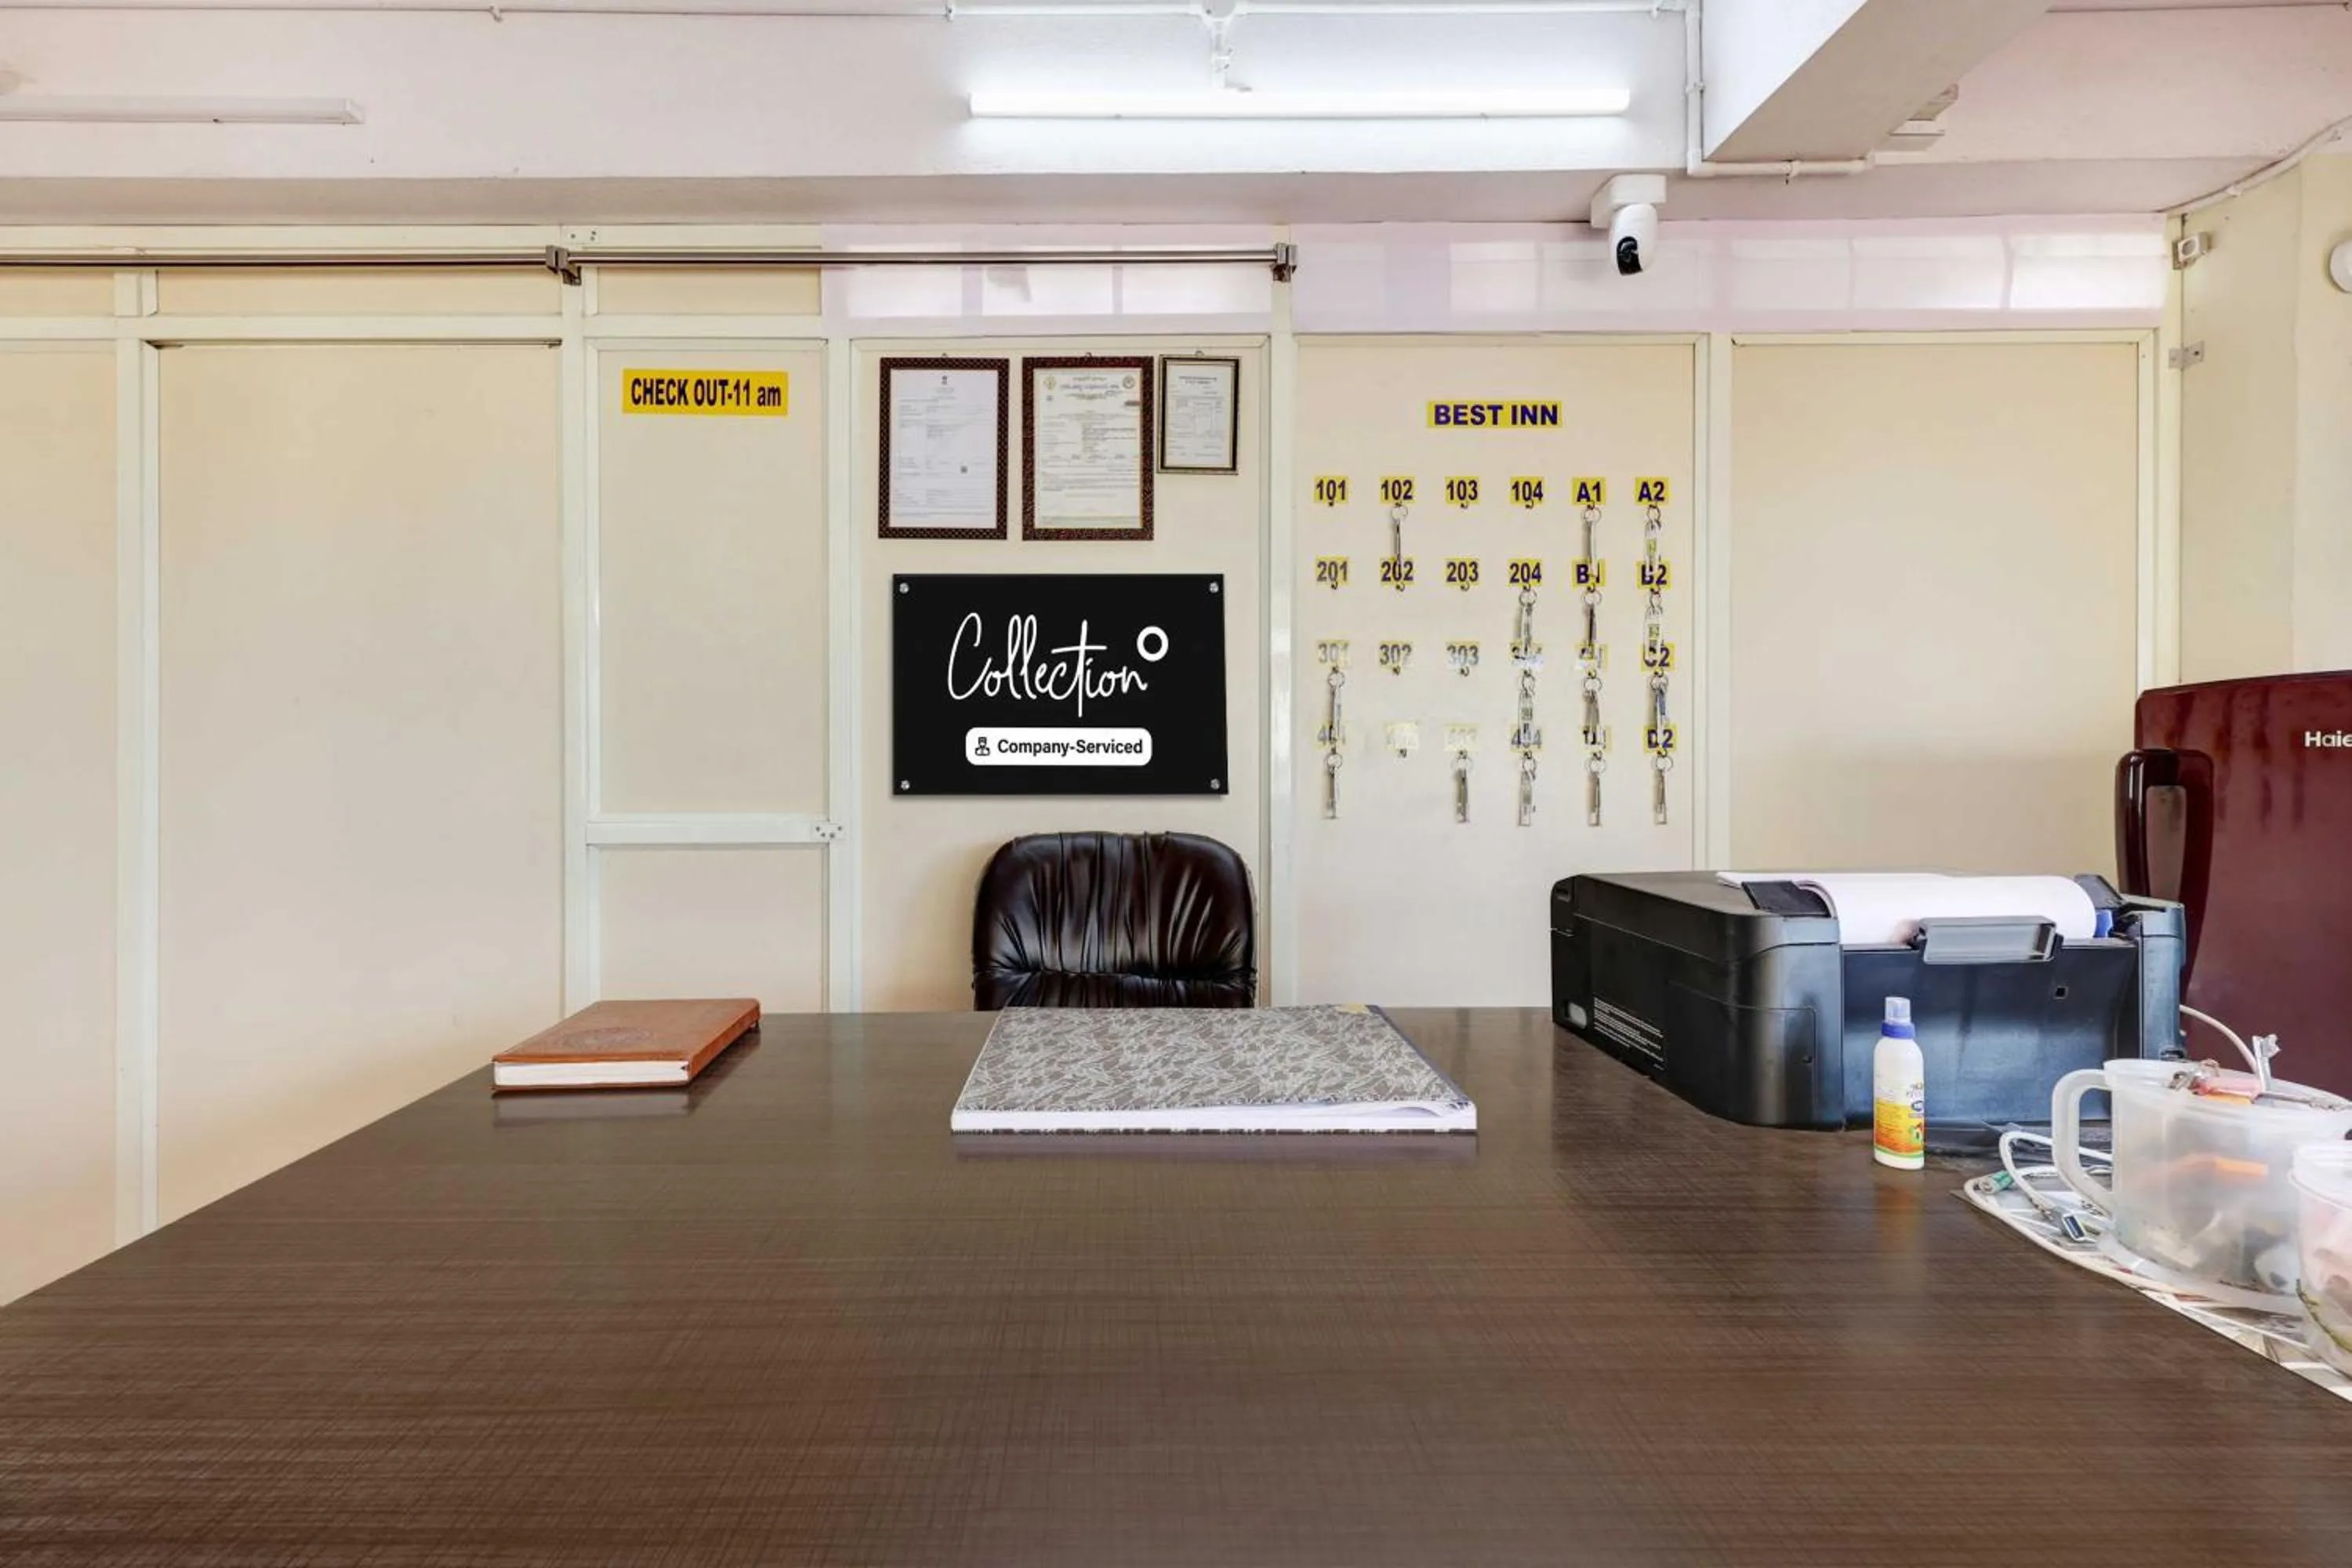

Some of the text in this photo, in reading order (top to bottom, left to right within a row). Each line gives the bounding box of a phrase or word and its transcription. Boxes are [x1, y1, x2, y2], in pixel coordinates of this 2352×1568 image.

[631, 378, 781, 406] CHECK OUT-11 am
[1434, 405, 1558, 425] BEST INN
[1316, 479, 1345, 500] 101
[1381, 479, 1413, 500] 102
[1446, 479, 1478, 500] 103
[1512, 481, 1543, 502] 104
[1577, 481, 1601, 503] A1
[1638, 481, 1664, 503] A2
[1317, 561, 1348, 582] 201
[1381, 561, 1414, 582] 202
[1446, 561, 1479, 582] 203
[1509, 562, 1541, 583] 204
[948, 612, 1148, 717] Collection
[997, 739, 1143, 757] Company-Serviced
